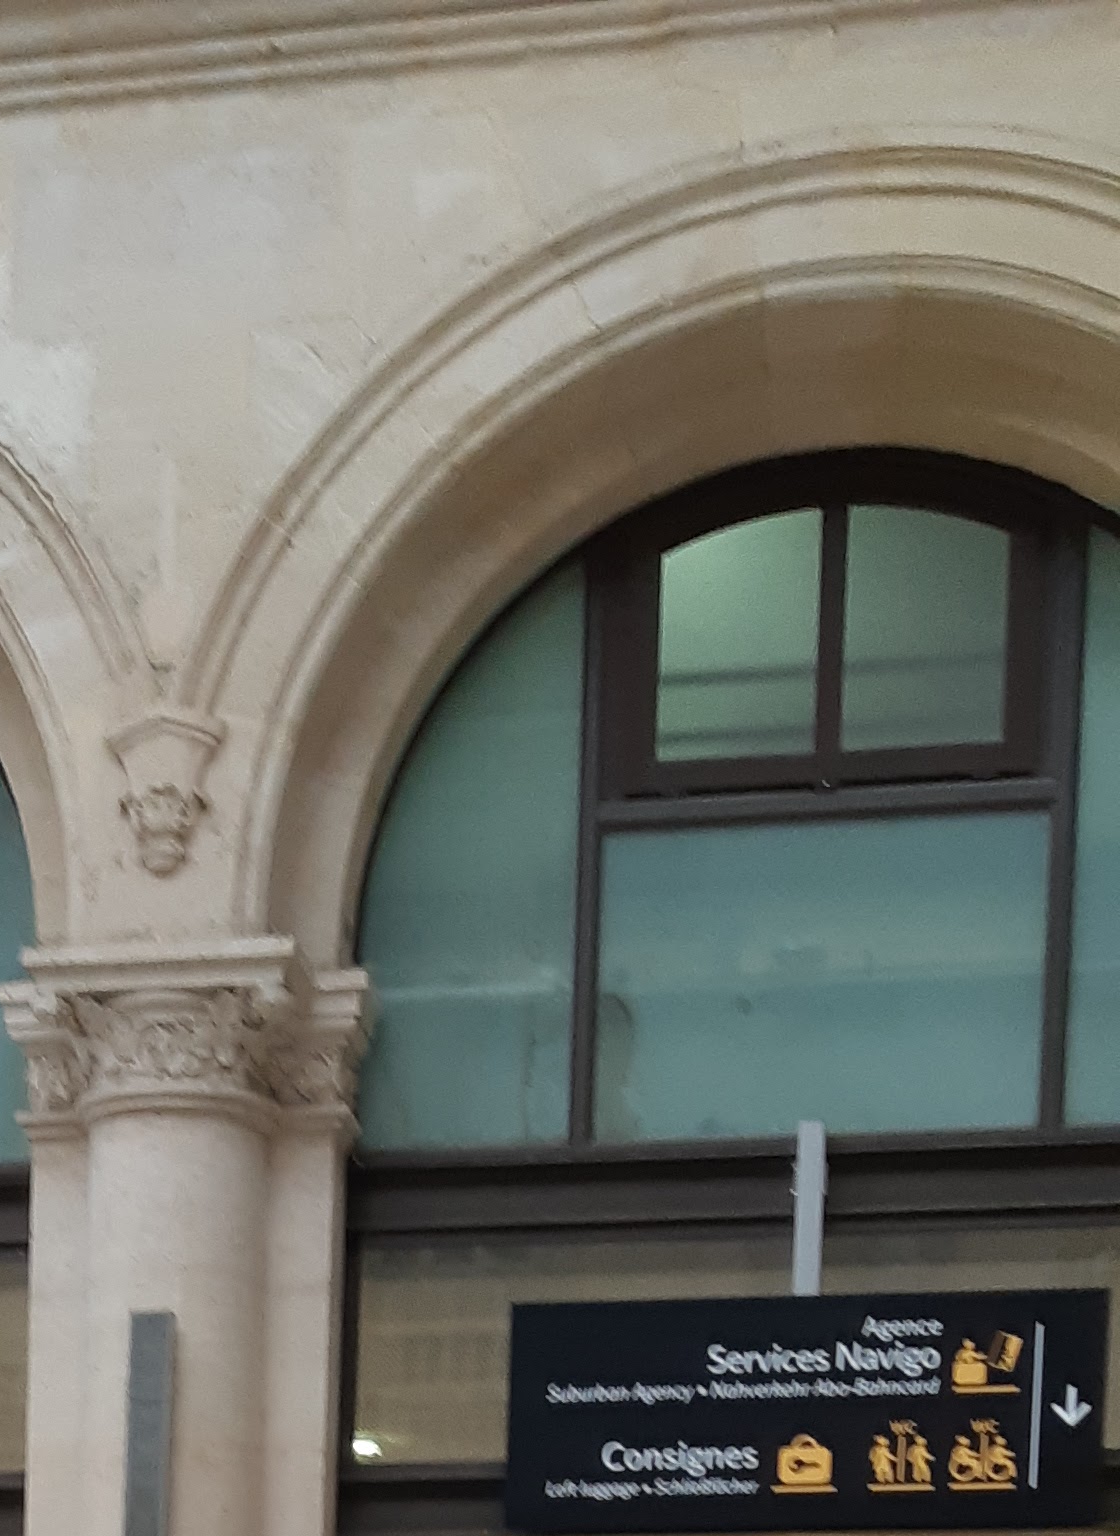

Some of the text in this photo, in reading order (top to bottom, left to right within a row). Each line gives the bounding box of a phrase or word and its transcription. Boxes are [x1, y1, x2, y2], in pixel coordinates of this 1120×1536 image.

[861, 1314, 943, 1342] Agence
[706, 1340, 942, 1377] Services Navigo
[547, 1381, 631, 1404] Suburban
[632, 1380, 695, 1406] Agency
[601, 1439, 759, 1477] Consignes
[545, 1479, 578, 1497] Left
[580, 1479, 640, 1500] luggage
